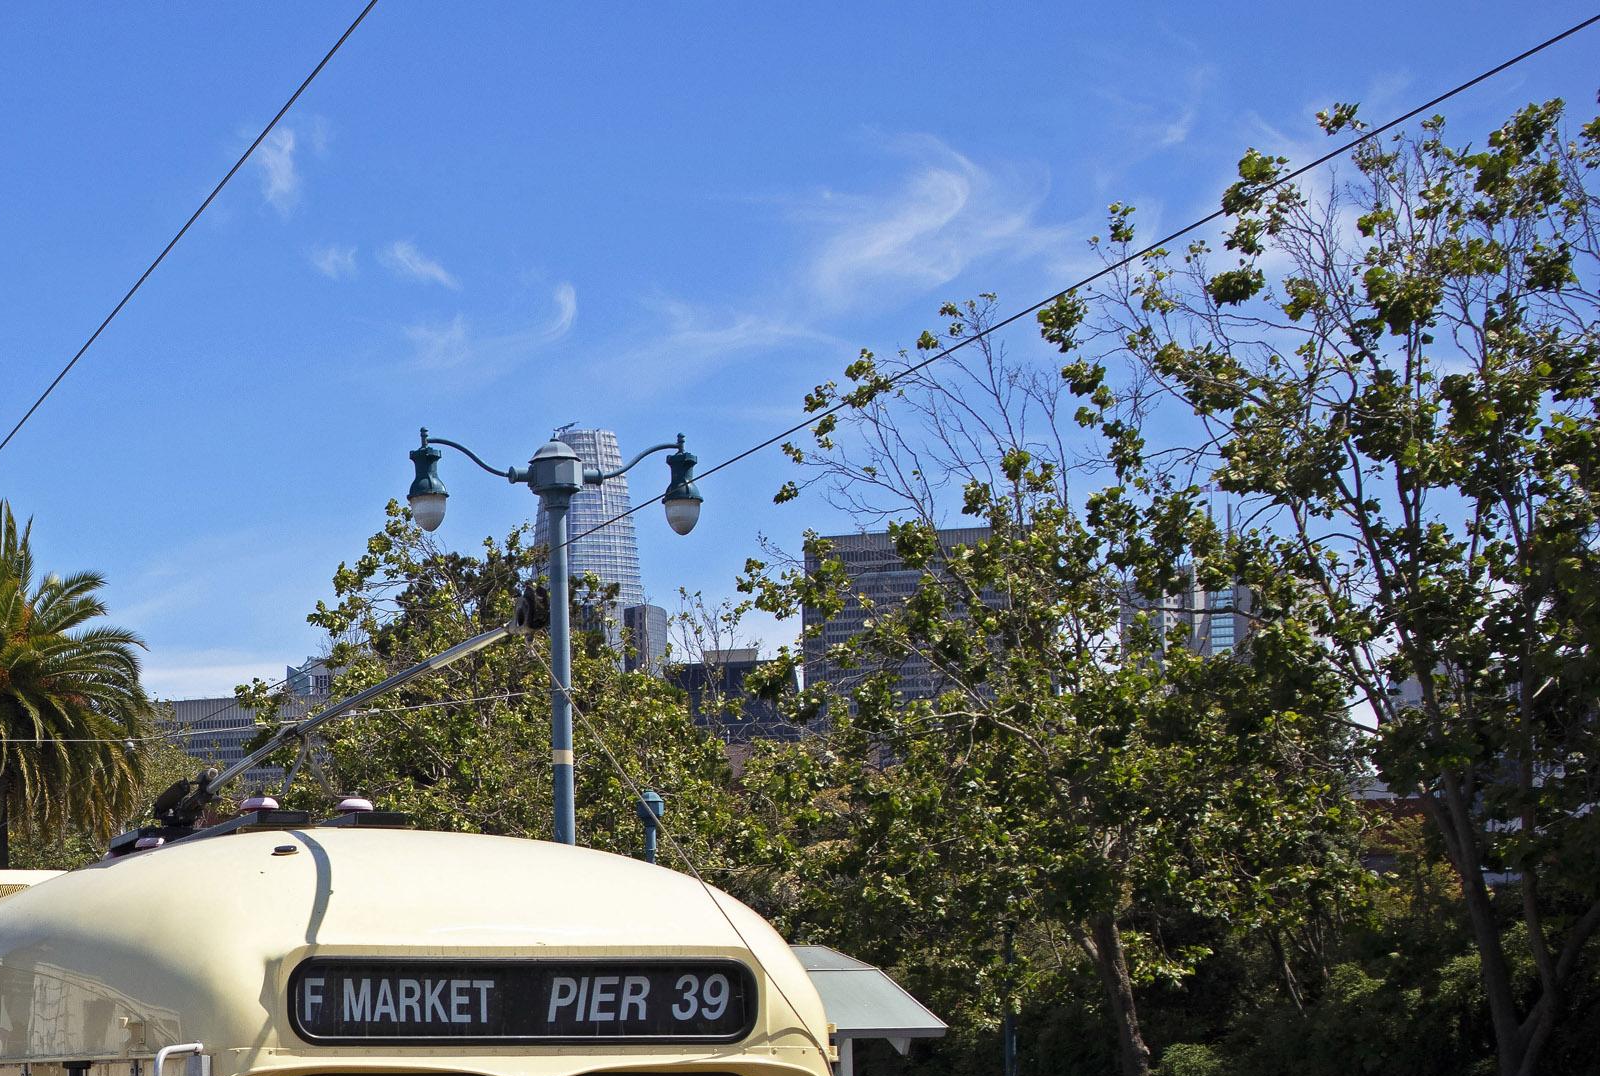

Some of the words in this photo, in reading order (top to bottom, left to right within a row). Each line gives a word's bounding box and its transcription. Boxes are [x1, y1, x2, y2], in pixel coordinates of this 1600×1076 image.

[304, 977, 325, 1022] F
[342, 977, 496, 1023] MARKET
[547, 975, 651, 1023] PIER
[671, 973, 730, 1021] 39
